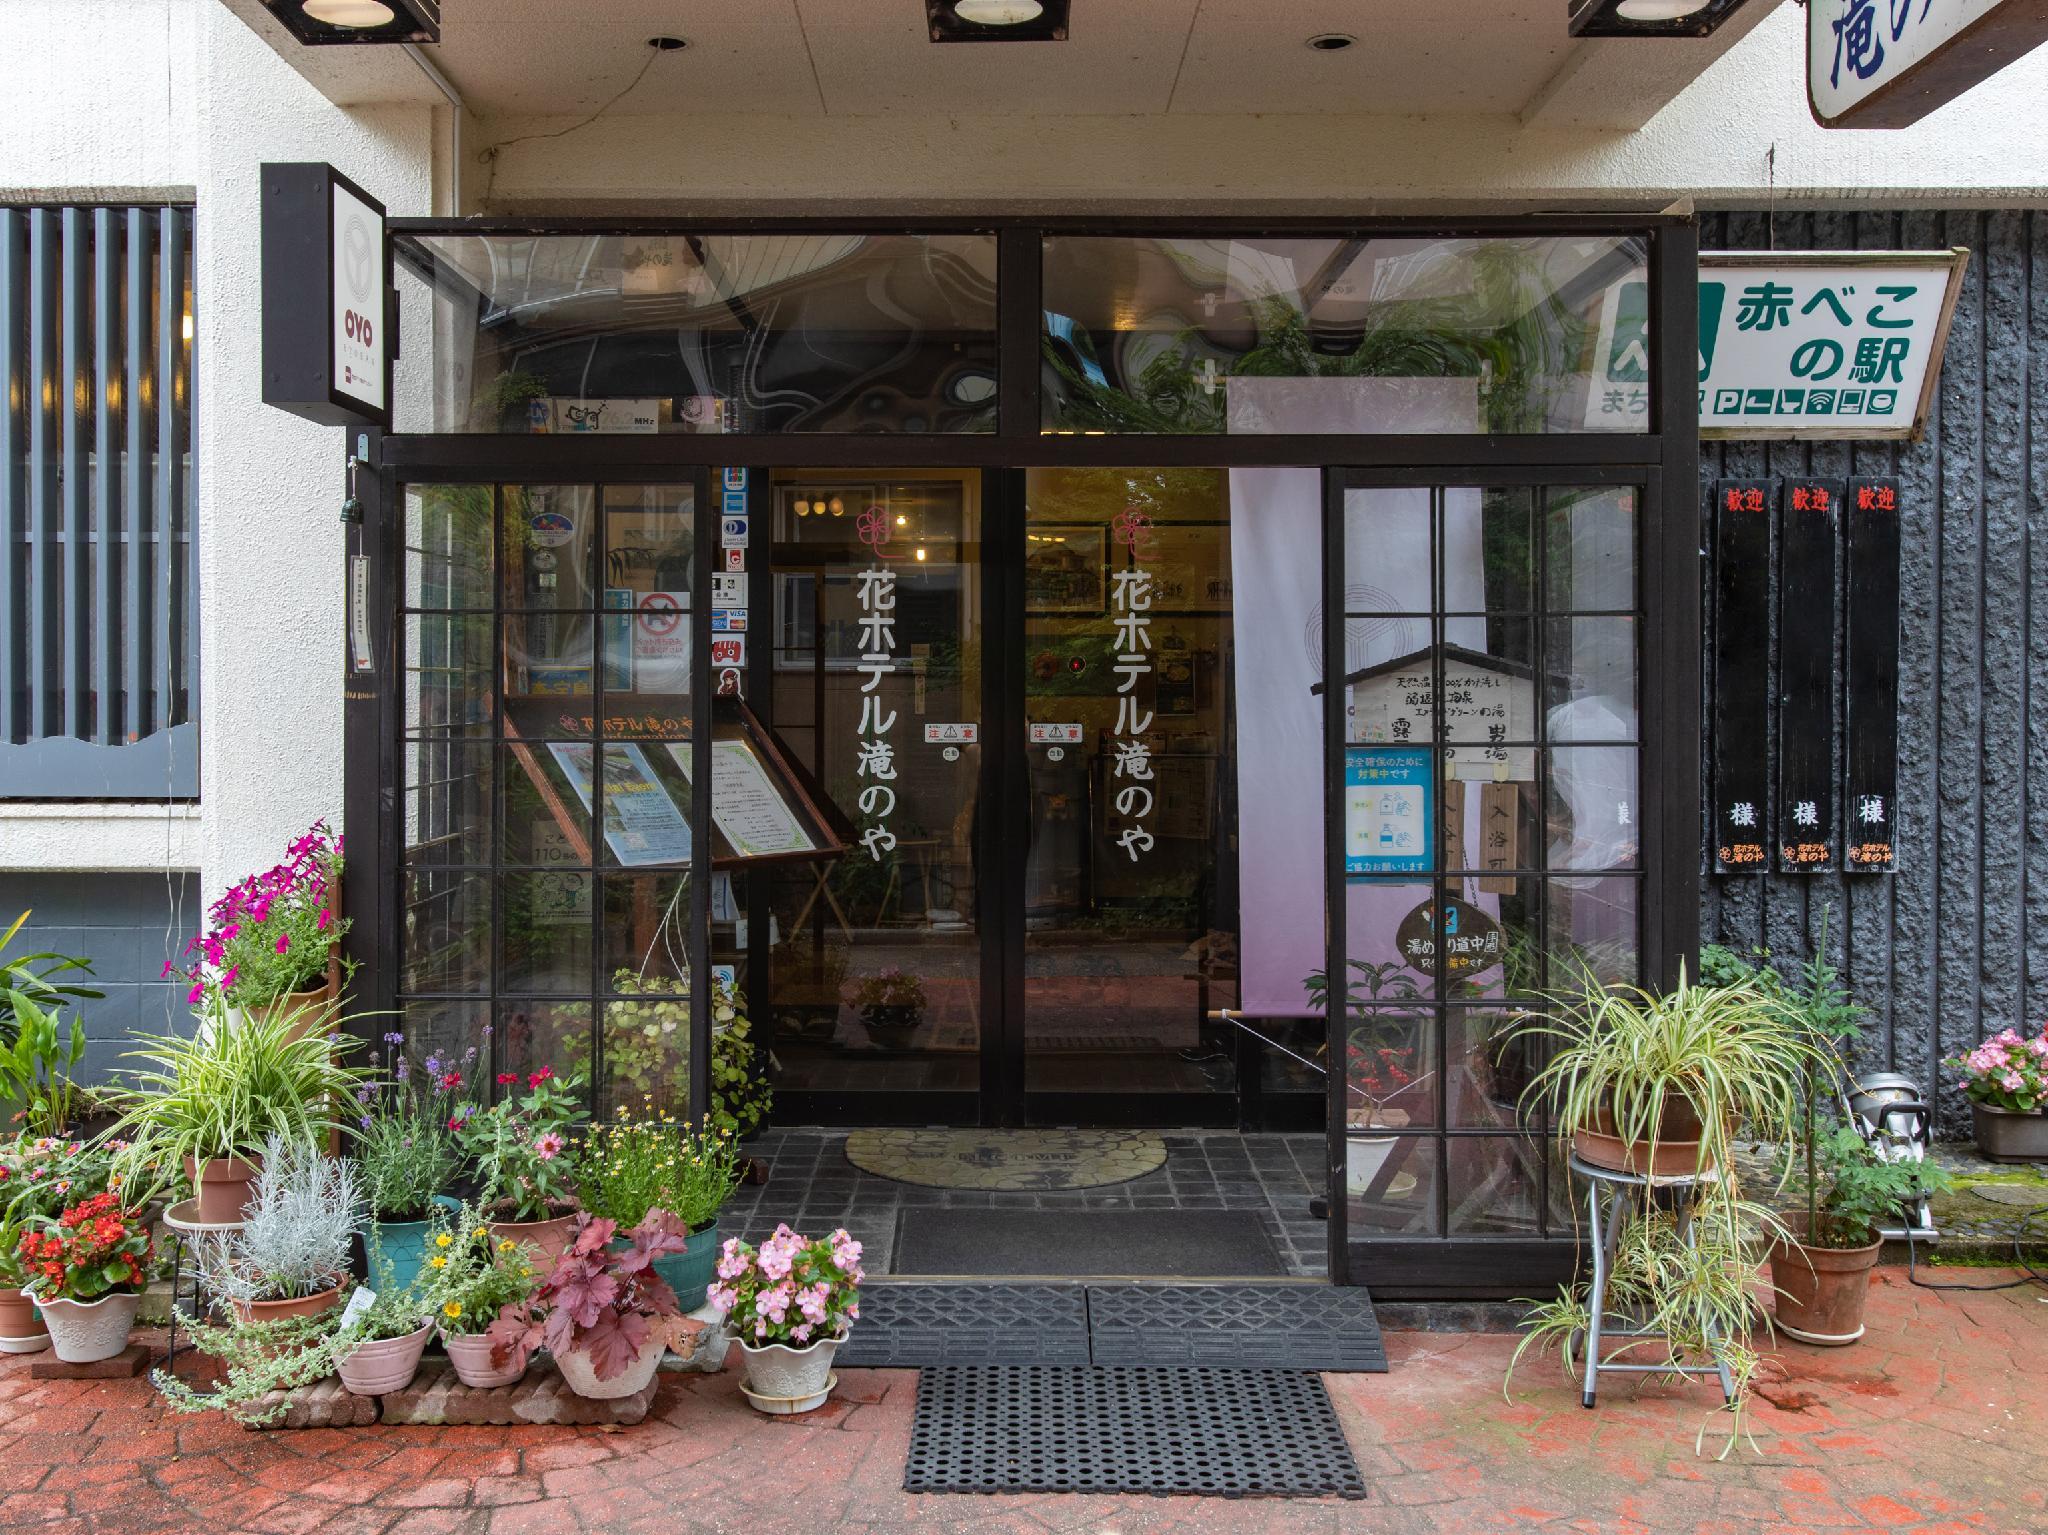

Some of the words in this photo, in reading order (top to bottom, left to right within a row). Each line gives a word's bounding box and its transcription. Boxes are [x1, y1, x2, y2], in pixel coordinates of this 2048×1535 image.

[1736, 281, 1919, 332] 赤べこ
[345, 309, 372, 348] OYO
[1789, 337, 1910, 384] の駅
[857, 569, 897, 862] 花ホテル滝のや
[1112, 569, 1155, 863] 花ホテル滝のや
[1730, 802, 1757, 827] 様
[1793, 801, 1819, 826] 様
[1859, 798, 1886, 824] 様
[1406, 936, 1485, 955] 湯めり道中
